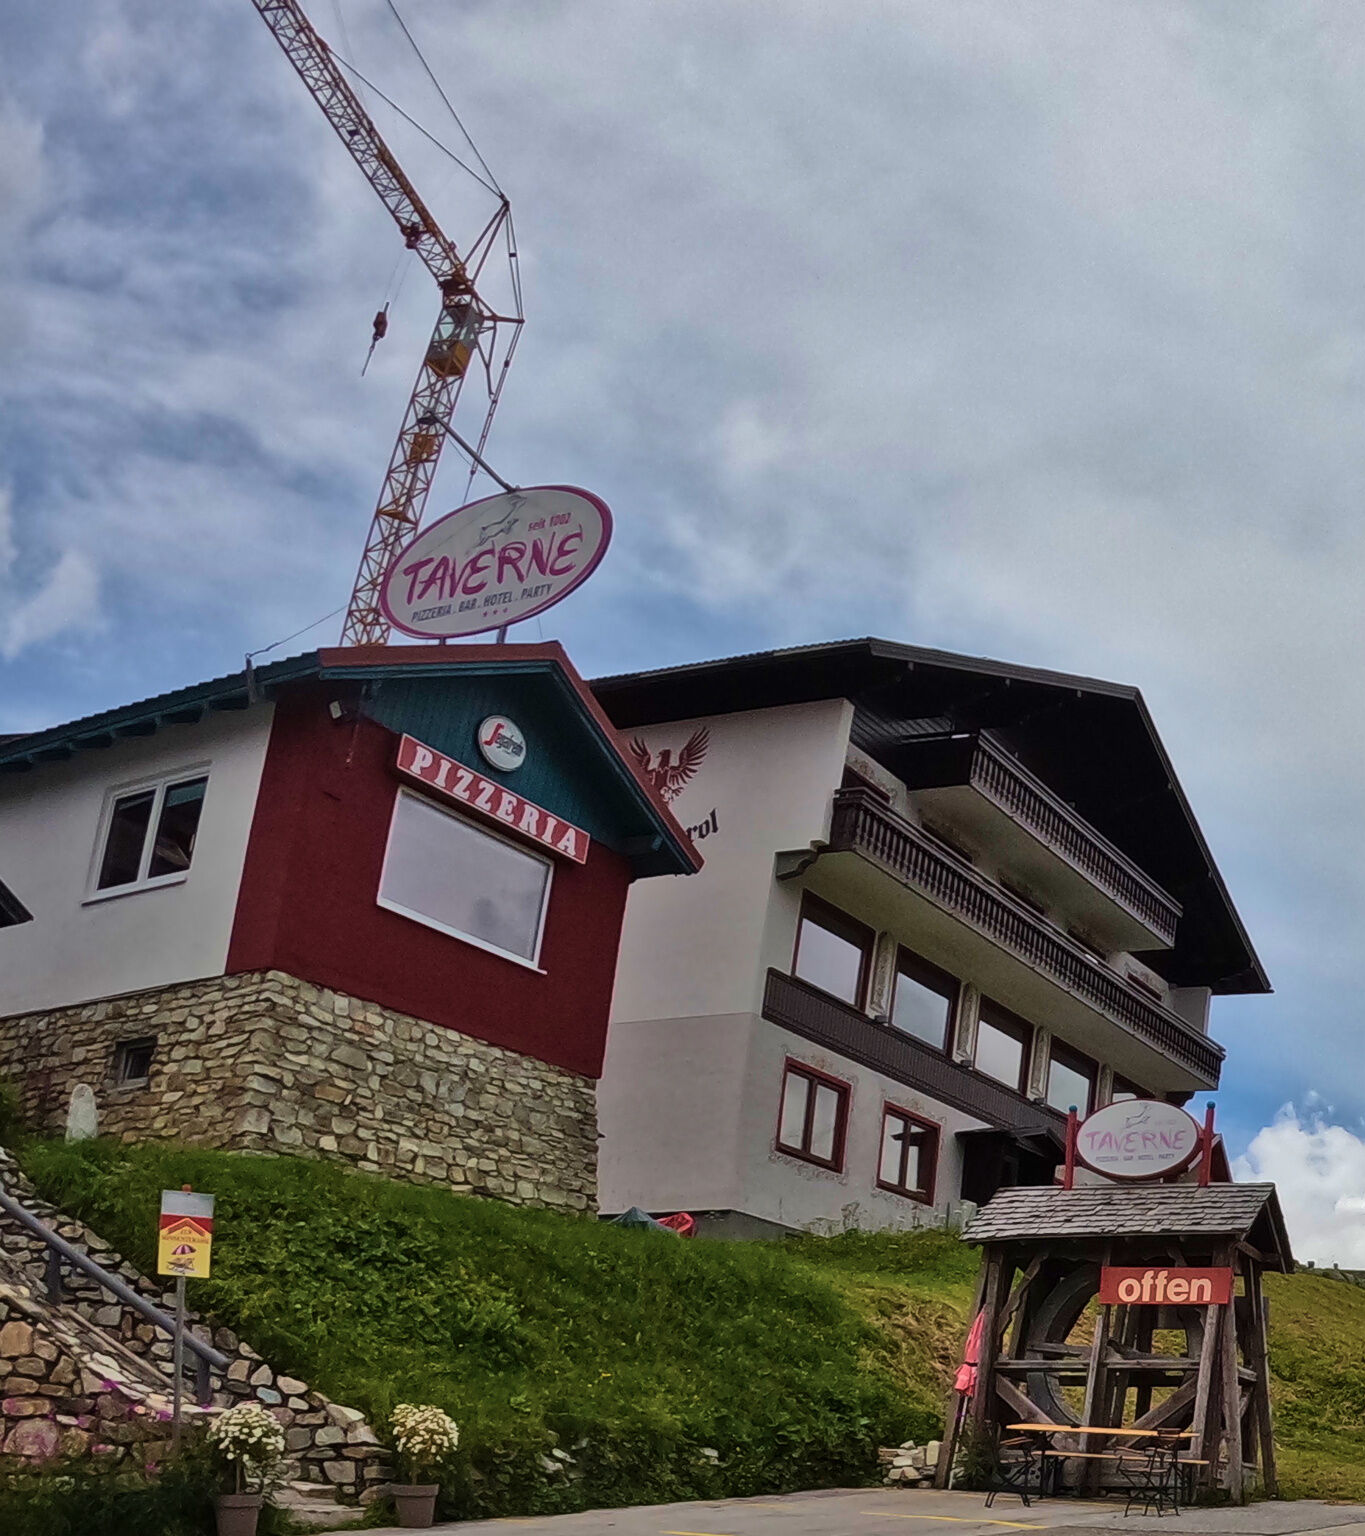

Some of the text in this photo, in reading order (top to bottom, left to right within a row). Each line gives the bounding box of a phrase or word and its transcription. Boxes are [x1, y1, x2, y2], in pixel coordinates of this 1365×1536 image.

[403, 524, 583, 605] TAVERNE
[411, 583, 553, 622] PIZZERIA BAR HOTEL PARTY
[409, 745, 576, 856] PIZZERIA
[686, 808, 719, 840] rol
[1085, 1130, 1186, 1152] TAVERNE
[1118, 1270, 1212, 1302] offen
